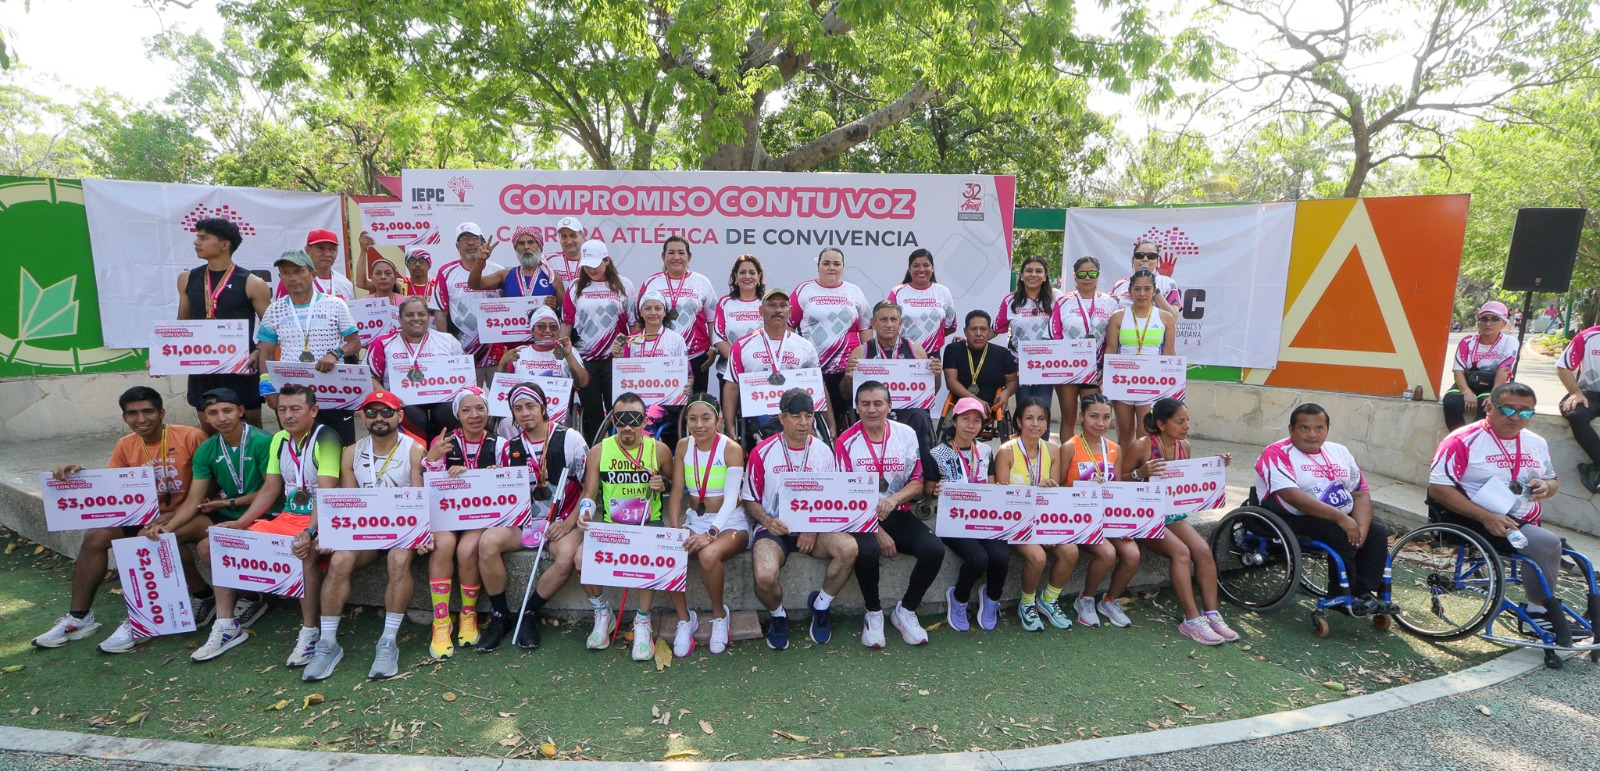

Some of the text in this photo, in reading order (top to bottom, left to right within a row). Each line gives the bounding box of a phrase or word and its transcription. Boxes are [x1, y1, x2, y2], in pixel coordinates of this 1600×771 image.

[412, 188, 444, 202] IEPC
[962, 183, 982, 200] 32
[501, 187, 913, 216] COMPROMISO CON TU VOZ
[371, 221, 430, 232] $2,000.00
[726, 228, 756, 244] DE
[762, 228, 918, 246] CONVIVENCIA
[486, 318, 530, 328] $2,000.
[162, 344, 236, 356] $1,000.00
[1027, 359, 1088, 370] $2,000.00
[401, 376, 466, 389] $1,000.00
[621, 379, 679, 390] $3,000.00
[883, 381, 926, 391] 000.00
[1112, 374, 1176, 386] $3,000.00
[308, 384, 362, 394] 000.00
[751, 387, 814, 401] $1,000
[606, 472, 649, 484] Rongo
[622, 487, 646, 496] CHIAP
[1166, 482, 1216, 497] 1,000.00
[57, 494, 145, 510] $3,000.00
[440, 494, 517, 511] $1,000.00
[791, 499, 868, 512] $2,000.00
[950, 507, 1022, 520] $1,000.00
[1033, 513, 1092, 525] ,000.00
[1104, 507, 1155, 518] 000.00
[331, 516, 417, 530] $3,000.00
[222, 555, 291, 574] $1,000.00
[595, 550, 676, 568] $3,000.00
[136, 548, 164, 624] $2,000.00
